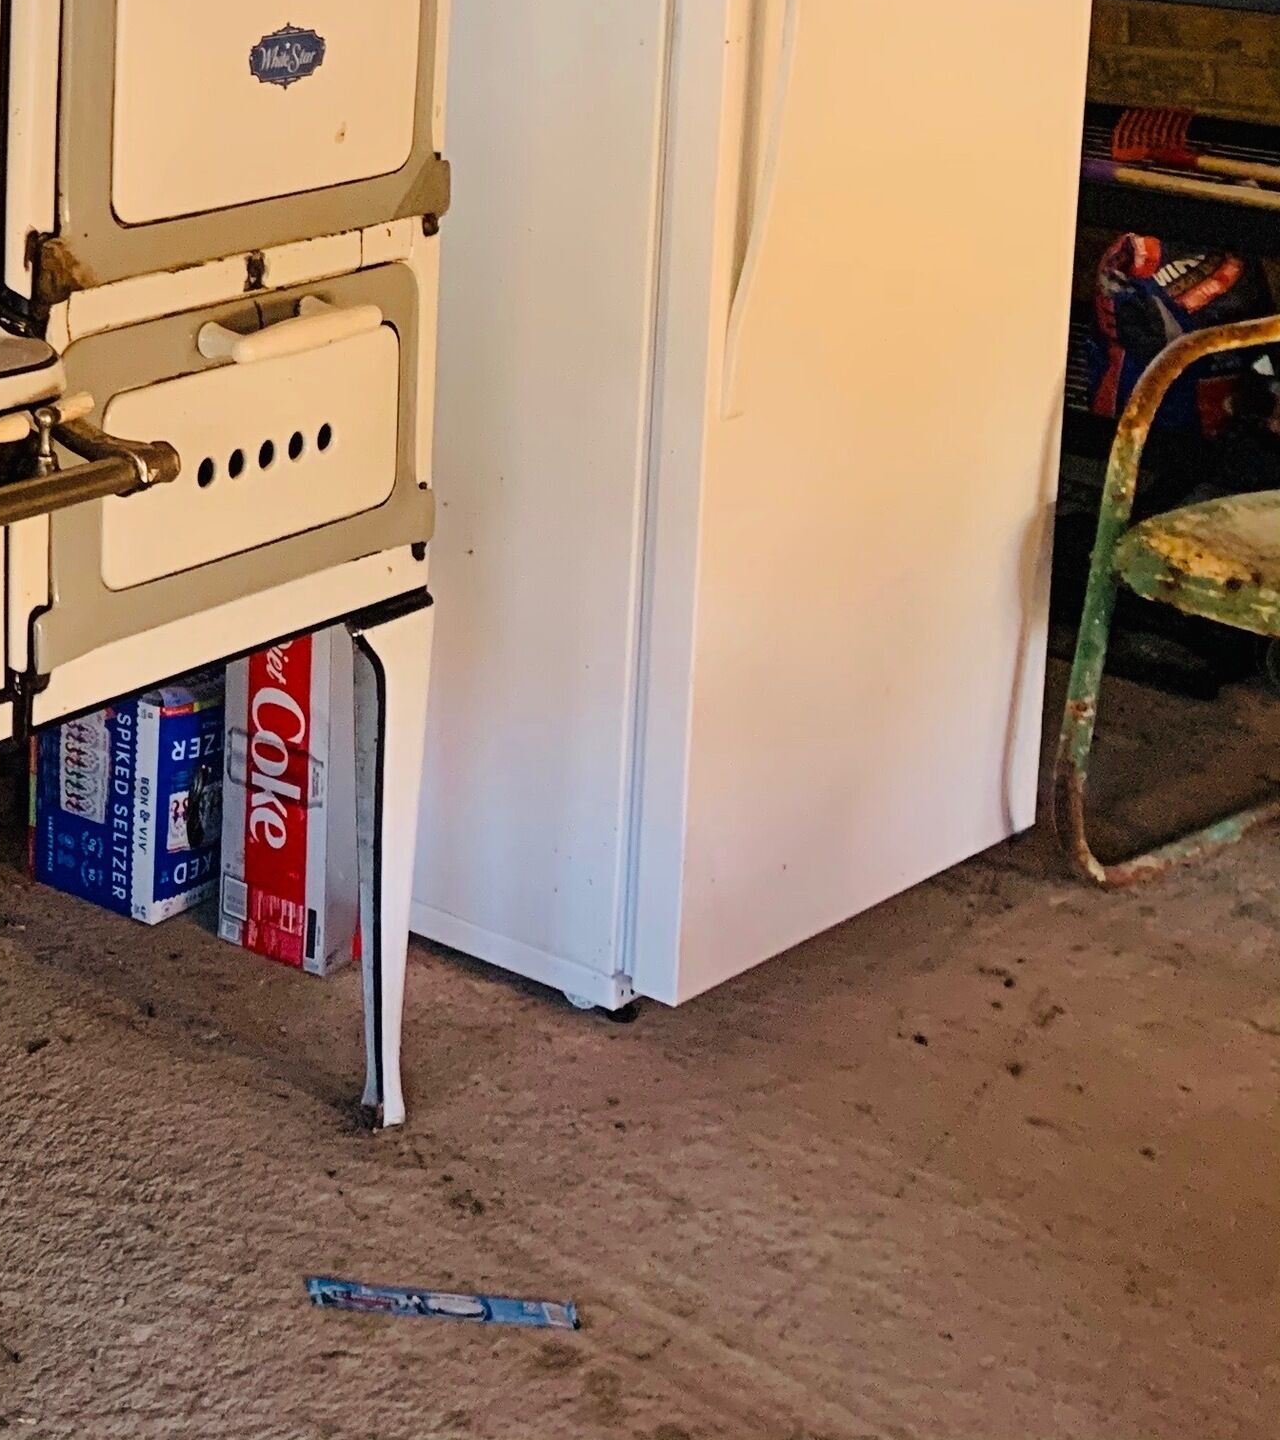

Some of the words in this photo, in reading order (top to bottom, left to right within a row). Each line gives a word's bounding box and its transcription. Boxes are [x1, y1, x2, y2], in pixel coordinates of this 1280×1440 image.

[260, 45, 290, 71] White
[287, 43, 316, 73] Star
[113, 711, 132, 796] SPIKED
[250, 686, 306, 849] Coke
[140, 776, 150, 806] BON
[140, 809, 151, 824] &
[111, 803, 129, 901] SELTZER
[138, 826, 149, 851] VIV
